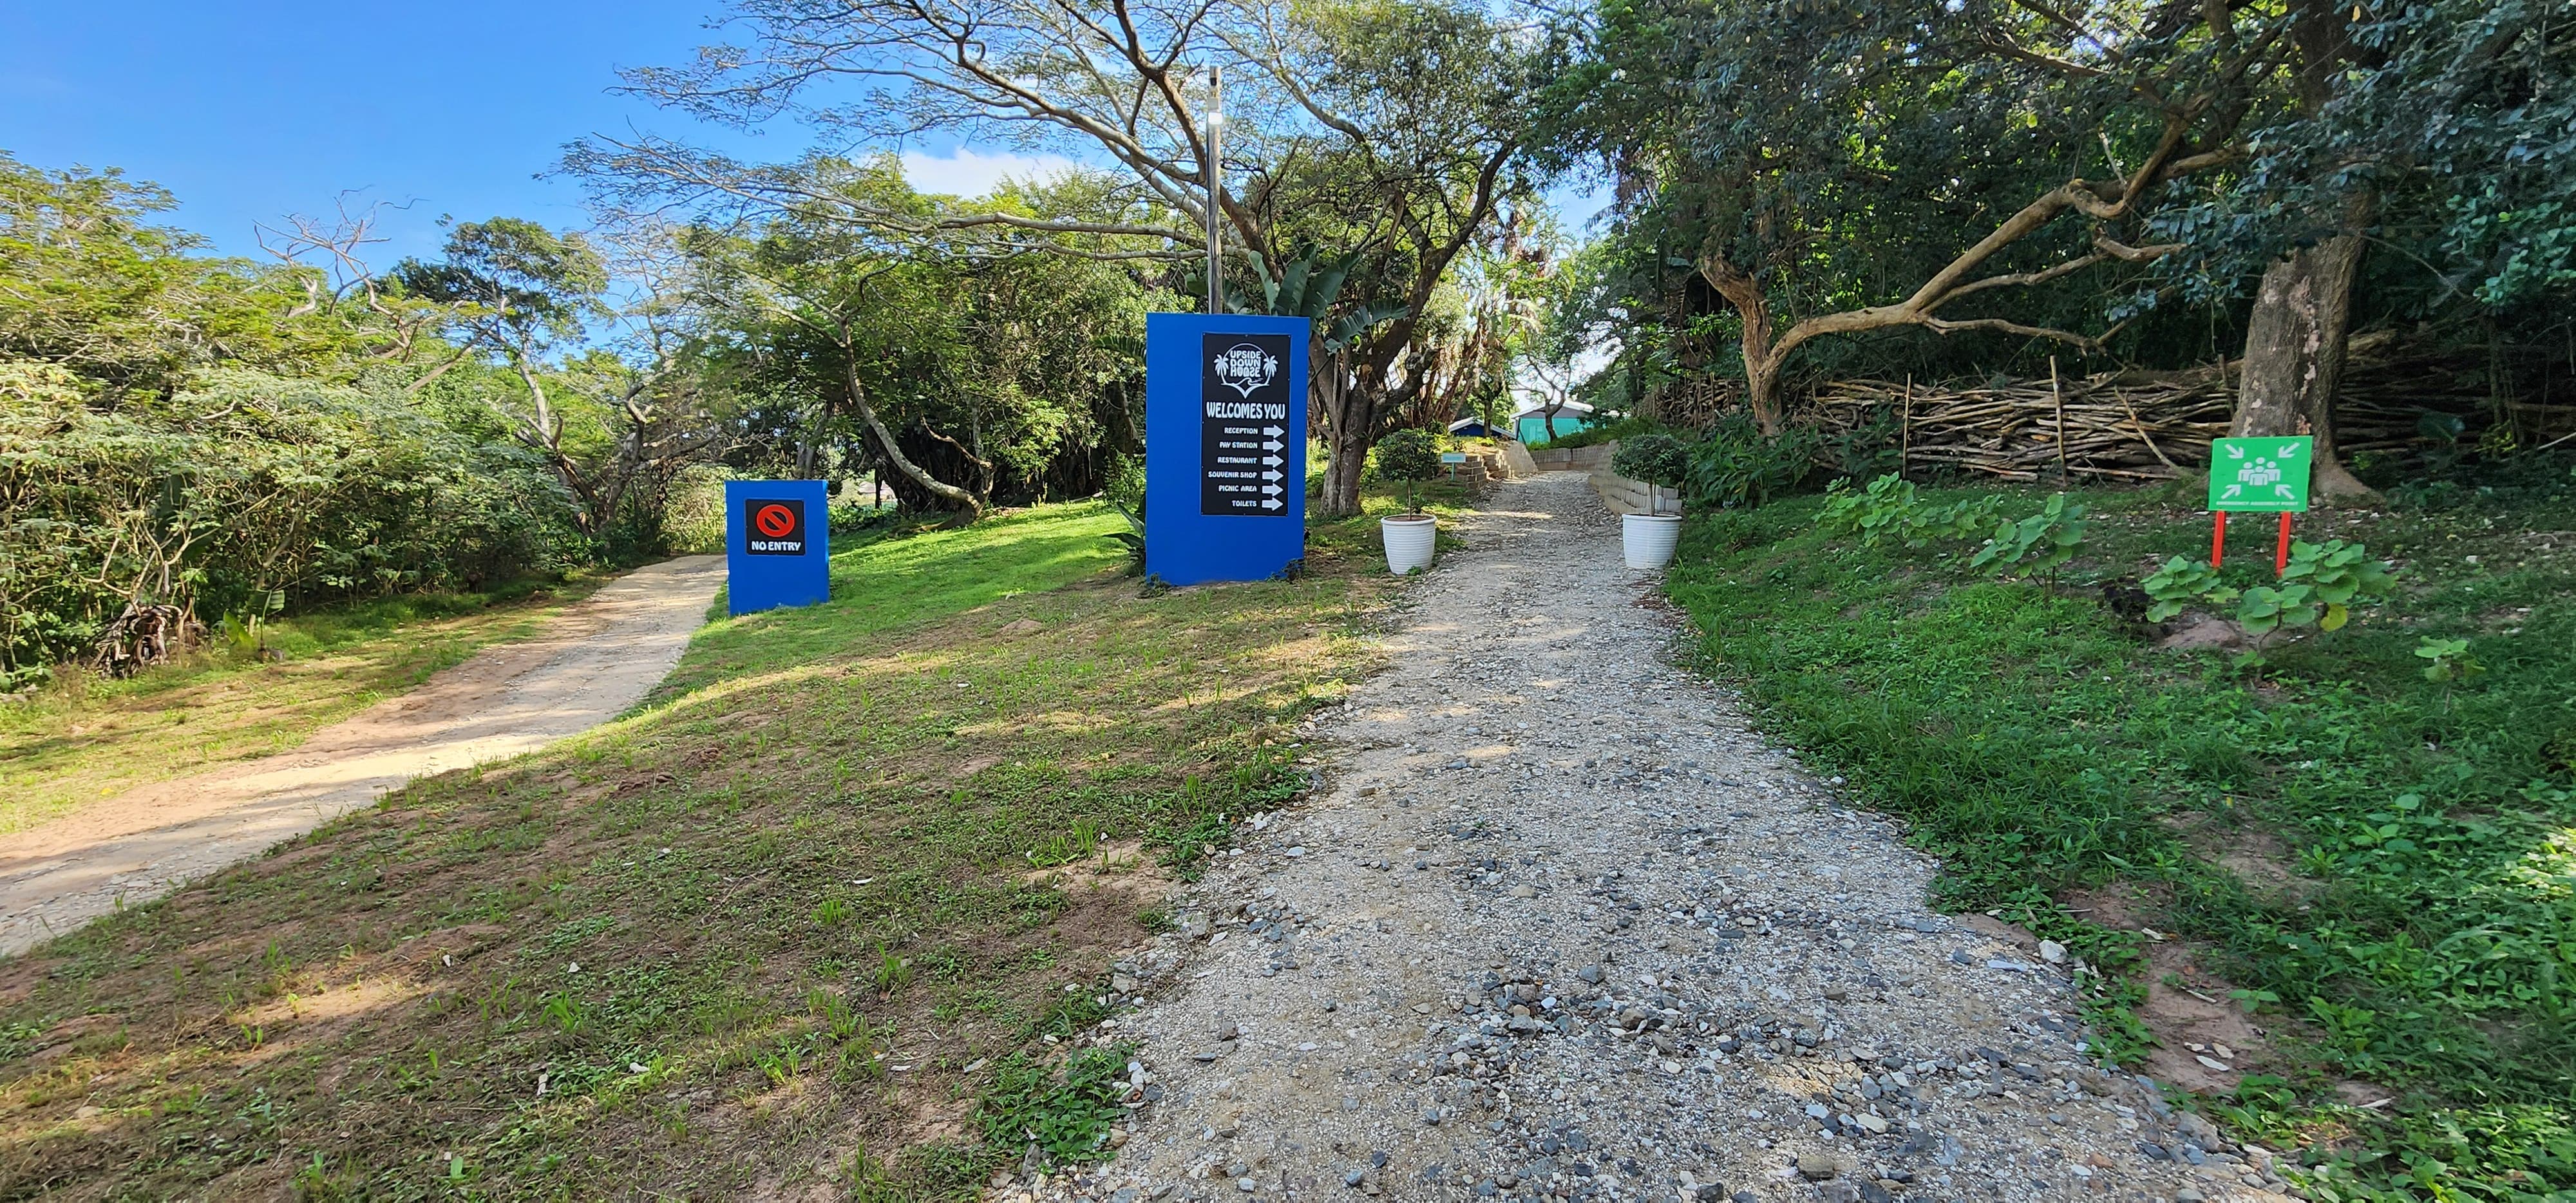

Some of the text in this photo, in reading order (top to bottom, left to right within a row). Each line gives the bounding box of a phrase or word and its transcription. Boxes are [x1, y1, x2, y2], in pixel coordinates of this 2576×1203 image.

[1230, 350, 1261, 359] UPSIDE
[1230, 359, 1261, 367] DOWN
[1206, 401, 1285, 419] WELCOMES YOU
[752, 541, 801, 551] NO ENTRY
